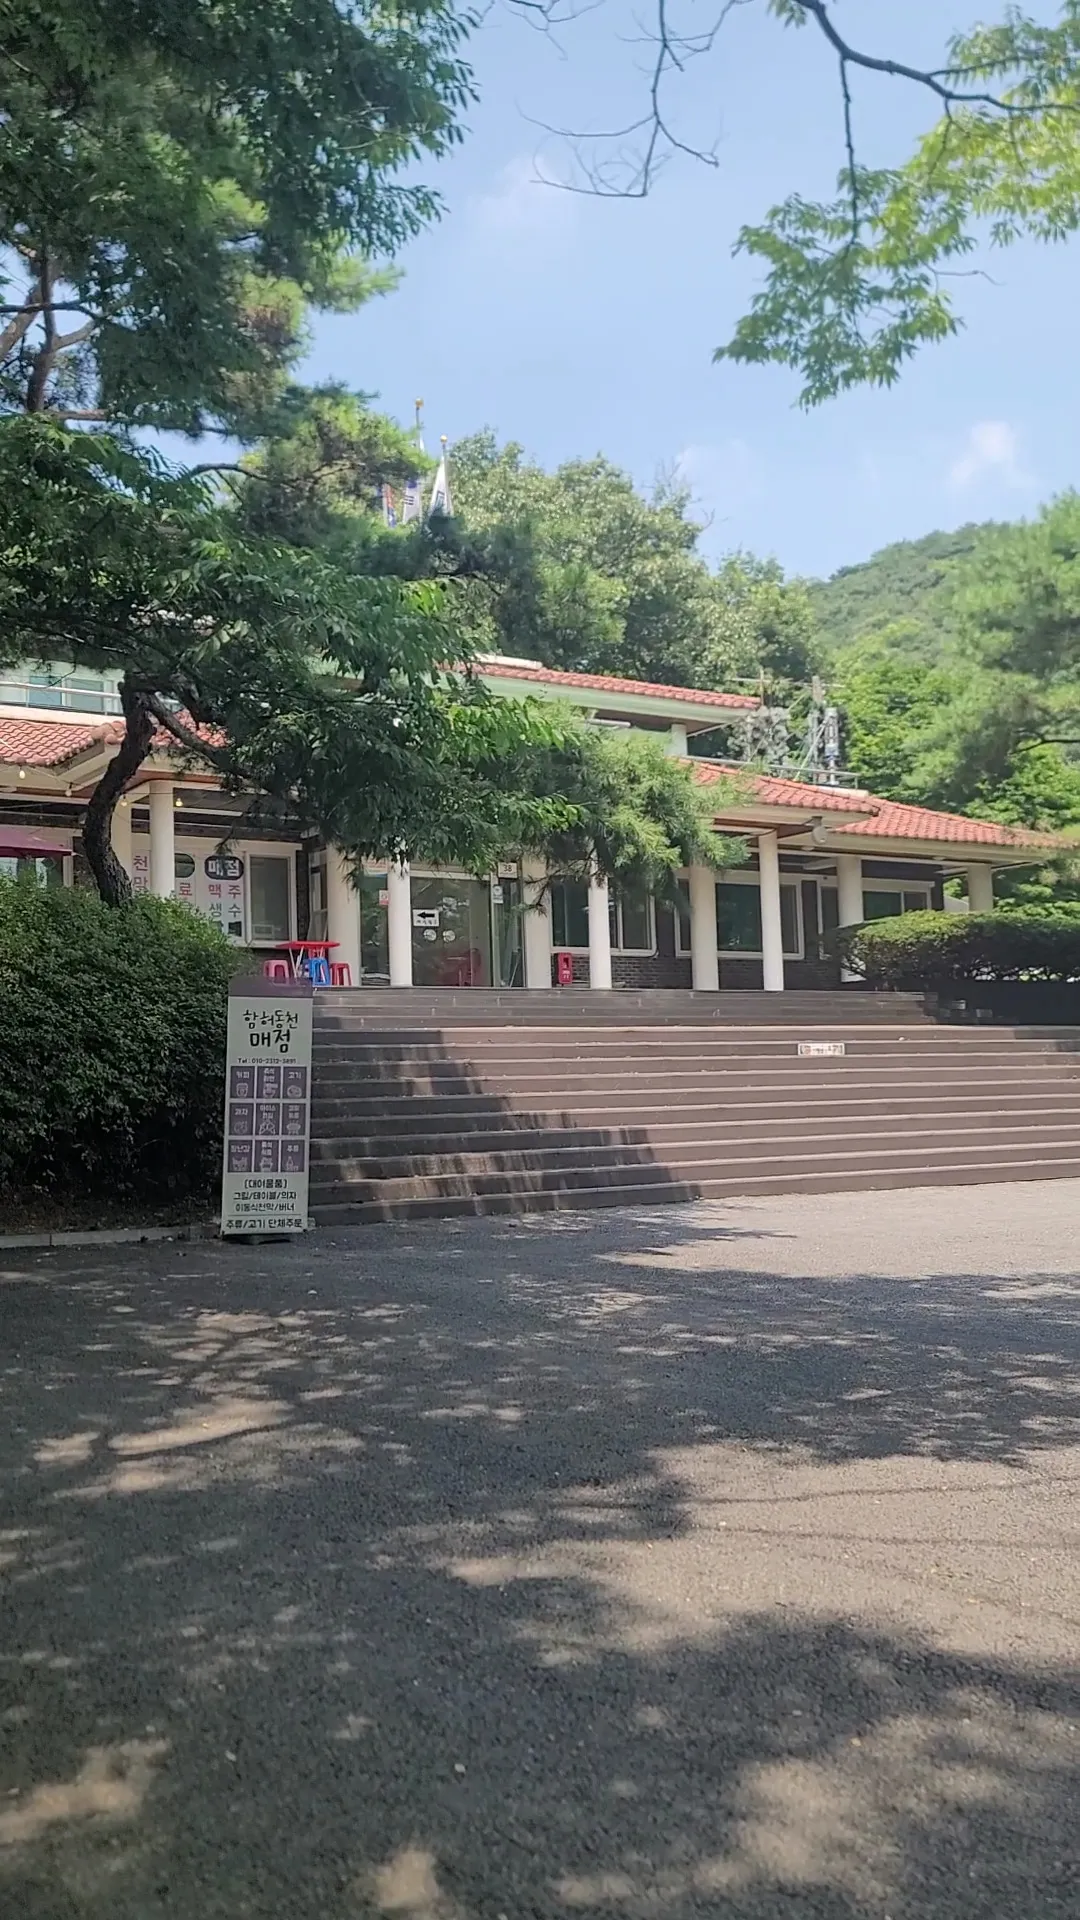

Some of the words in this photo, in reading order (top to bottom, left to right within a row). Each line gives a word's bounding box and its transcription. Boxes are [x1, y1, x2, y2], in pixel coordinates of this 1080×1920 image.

[208, 859, 240, 877] 매점
[208, 884, 242, 899] 맥주
[209, 902, 242, 918] 생수
[242, 1009, 298, 1029] 함허동천
[249, 1029, 291, 1053] 매점
[226, 1219, 266, 1229] 주류/고기
[268, 1218, 303, 1228] 단체주문
